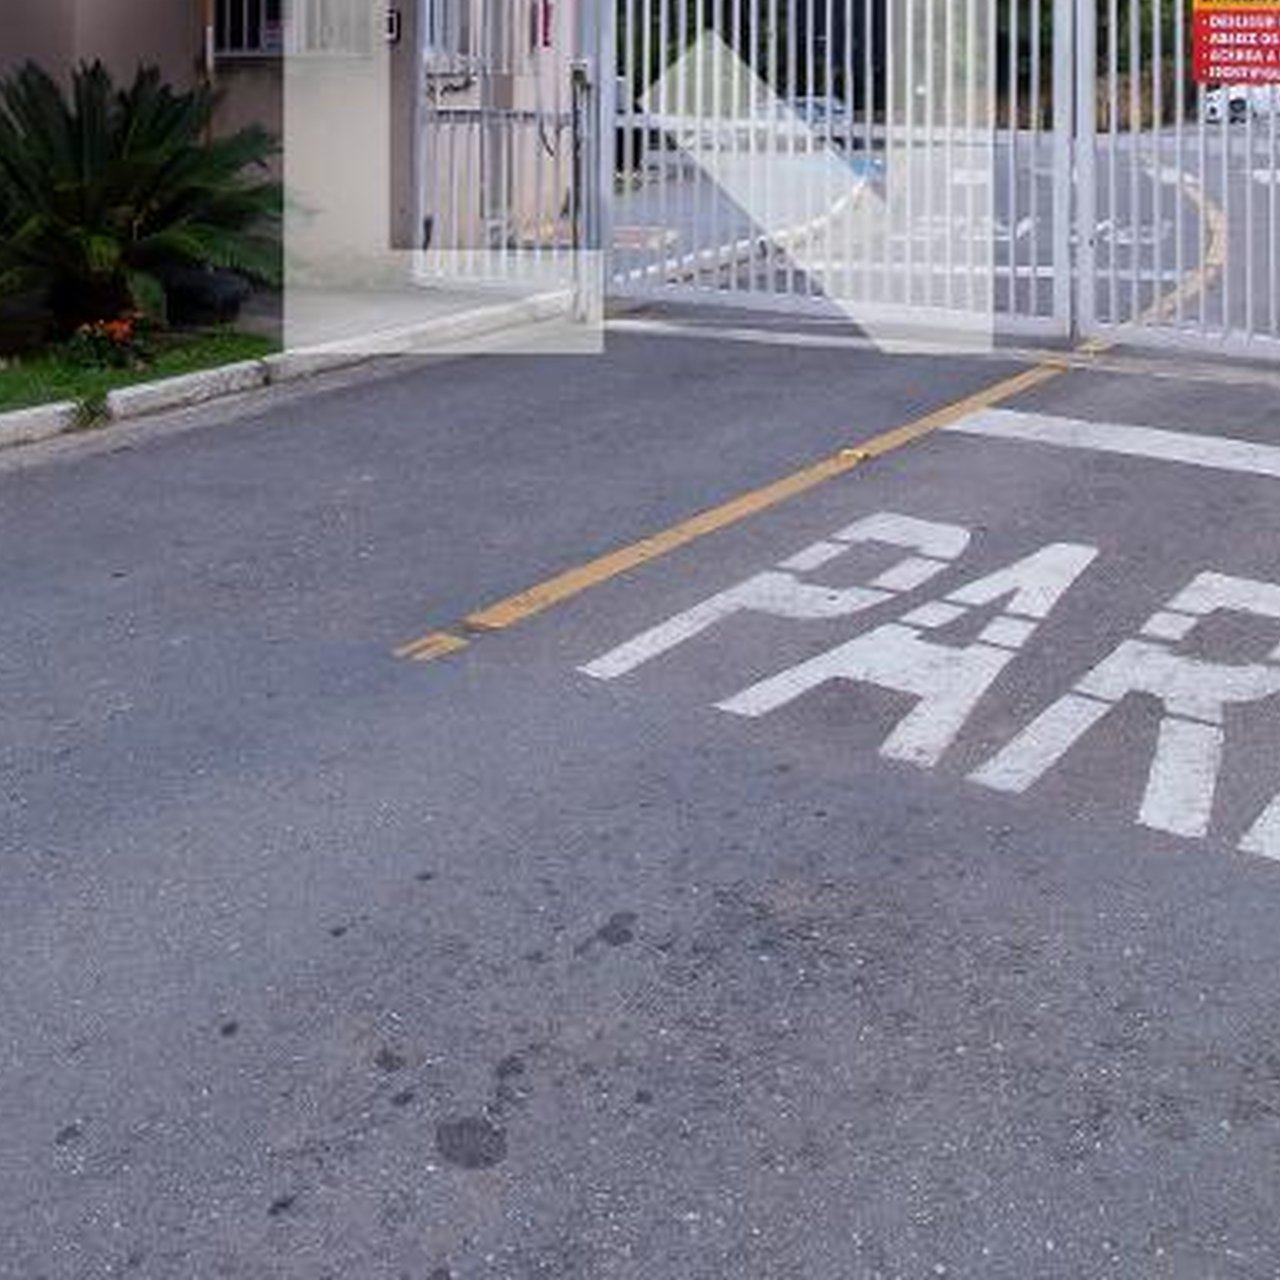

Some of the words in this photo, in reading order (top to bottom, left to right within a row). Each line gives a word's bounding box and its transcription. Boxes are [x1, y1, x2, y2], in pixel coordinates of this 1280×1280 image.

[1208, 32, 1258, 45] ABAIXE
[1260, 32, 1279, 45] OS
[1209, 48, 1263, 62] ACENDA
